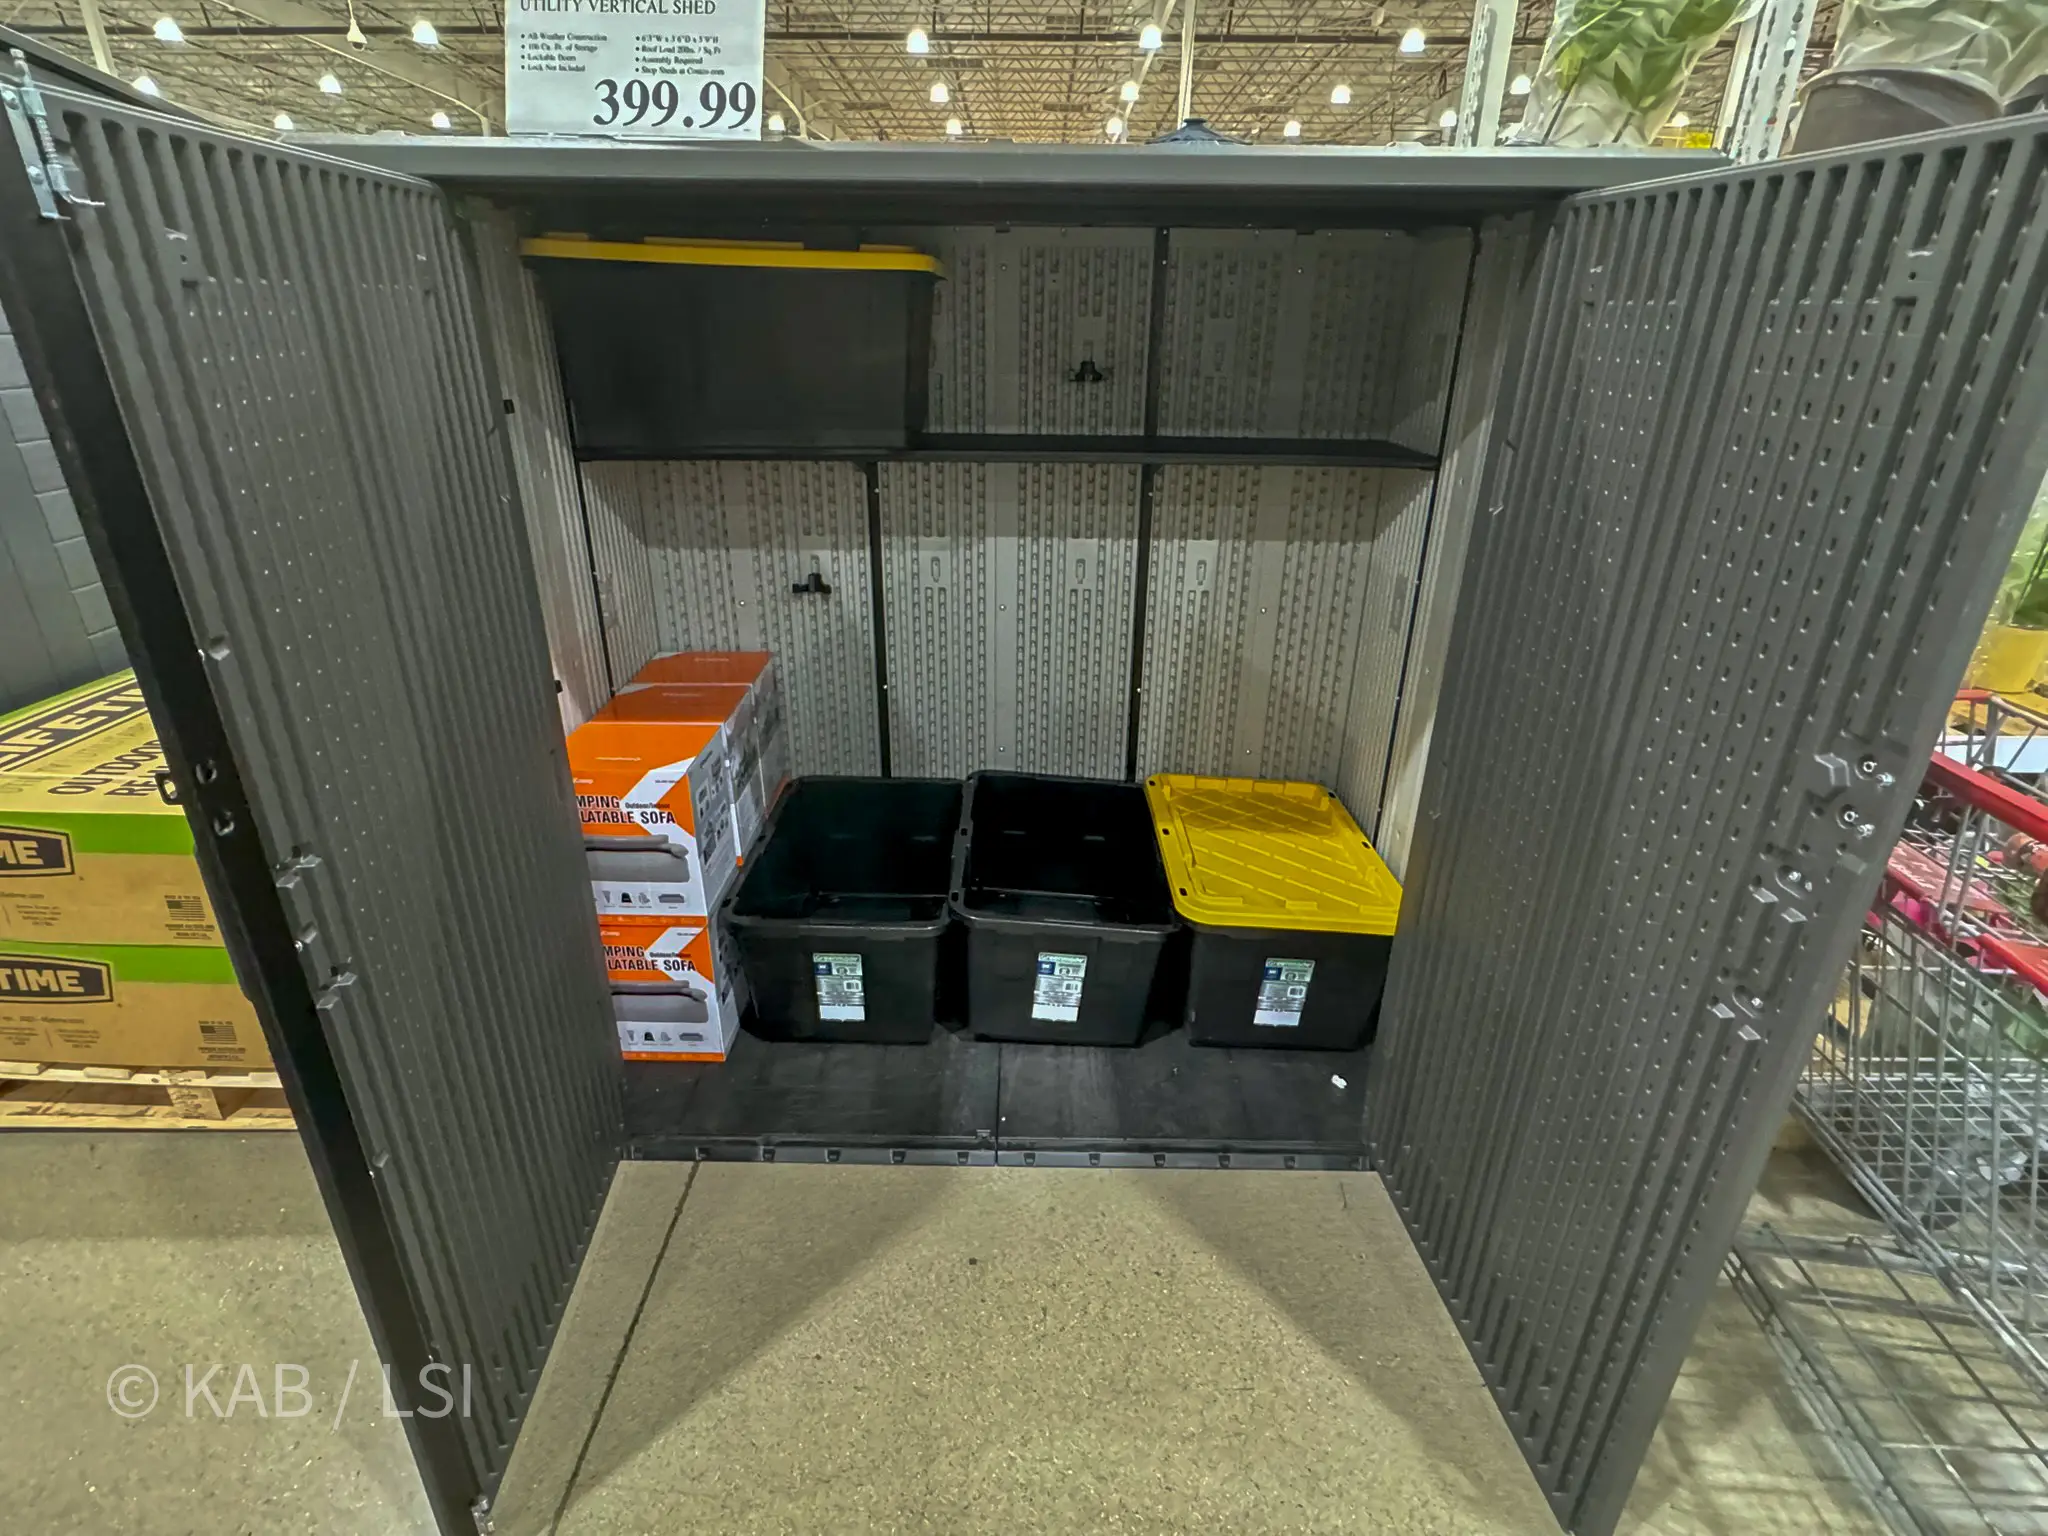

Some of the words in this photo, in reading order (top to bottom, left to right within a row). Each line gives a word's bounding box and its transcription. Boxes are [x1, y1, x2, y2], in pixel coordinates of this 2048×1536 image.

[520, 0, 581, 12] UTILITY
[589, 0, 669, 14] VERTICAL
[672, 0, 716, 15] SHED
[567, 33, 607, 41] Construction
[574, 44, 598, 53] Storage
[528, 53, 556, 61] Lockable
[558, 53, 576, 61] Doors
[641, 56, 671, 65] Assembly
[674, 56, 703, 65] Required
[558, 64, 586, 72] Included
[593, 78, 757, 129] 399.99
[581, 811, 636, 824] LATABLE
[640, 811, 676, 824] SOFA
[608, 959, 658, 970] LATABLE
[664, 959, 696, 971] SOFA
